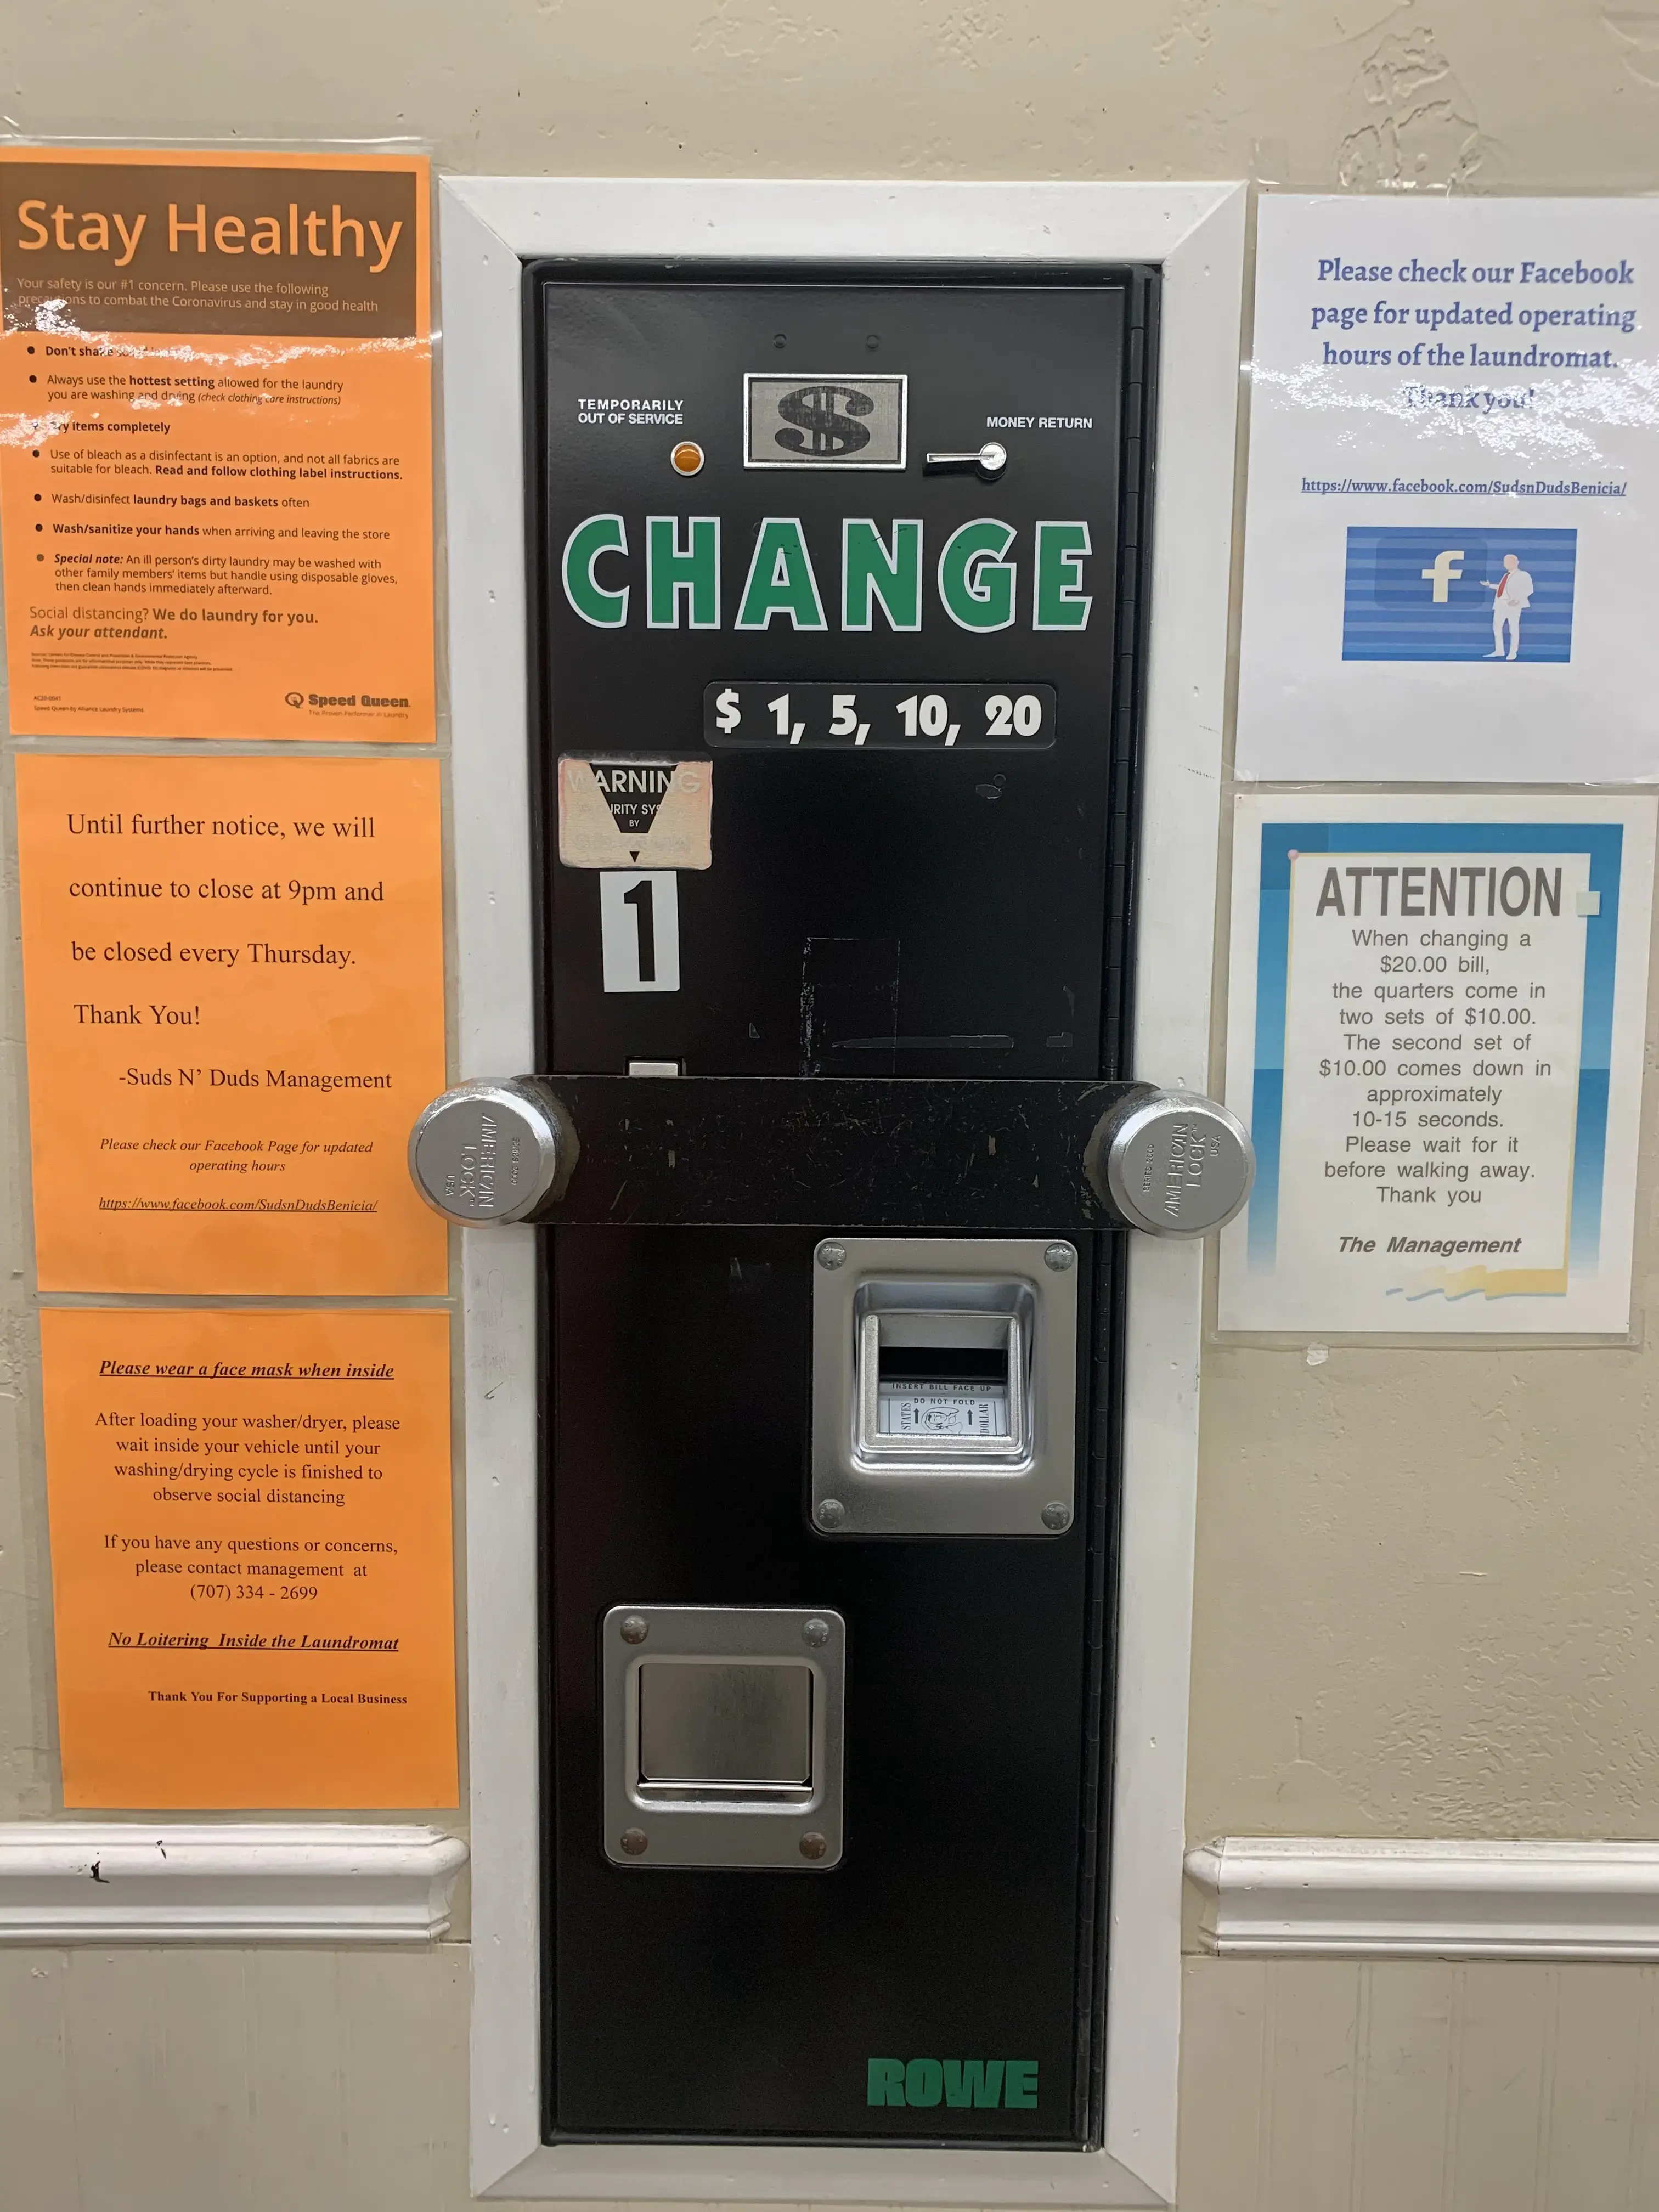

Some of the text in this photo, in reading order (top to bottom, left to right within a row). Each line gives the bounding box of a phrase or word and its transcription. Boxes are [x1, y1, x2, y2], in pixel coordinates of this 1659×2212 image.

[19, 200, 403, 273] Stay Healthy
[1318, 257, 1634, 284] Please check our Facebook
[1311, 301, 1637, 333] page for updated operating
[1323, 341, 1618, 368] hours of the laundromat.
[578, 399, 683, 410] TEMPORARILY
[578, 413, 682, 424] OUT OF SERVICE
[987, 417, 1092, 428] MONEY RETURN
[1302, 478, 1627, 496] https://www.facebook.com/SudsnDudsBenicia/
[52, 494, 309, 508] Wash/disinfect laundry bags and baskets often
[53, 524, 390, 541] Wash/sanitize your hands when arriving and leaving the store
[562, 514, 1093, 632] CHANGE
[30, 607, 318, 626] Social distancing? We do laundry for you.
[30, 625, 167, 640] Ask your attendant.
[309, 694, 356, 708] Speed
[715, 689, 1042, 746] $ 1, 5, 10, 20
[67, 814, 374, 839] Until further notice, we will
[70, 877, 384, 905] continue to close at 9pm and
[1316, 867, 1561, 916] ATTENTION
[624, 880, 655, 982] 1
[1352, 930, 1531, 951] When changing a
[71, 941, 355, 969] be closed every Thursday.
[1380, 955, 1489, 975] $20.00 bill,
[1333, 982, 1545, 1002] the quarters come in
[74, 1005, 199, 1025] Thank You!
[1340, 1007, 1535, 1026] two sets of $10.00.
[119, 1068, 172, 1085] -Suds
[210, 1070, 259, 1086] Duds
[266, 1070, 392, 1092] Management
[1367, 1085, 1502, 1106] approximately
[1353, 1111, 1503, 1127] 10-15 seconds.
[1210, 1135, 1221, 1156] USA
[478, 1113, 498, 1207] AMERICAN
[1164, 1123, 1188, 1217] AMERICAN
[445, 1175, 455, 1196] USA
[99, 1197, 378, 1212] https://www.facebook.com/SudsnDudsBenicia/
[1340, 1237, 1522, 1257] The Management
[99, 1361, 393, 1380] Please wear a face mask when inside
[901, 1402, 911, 1430] STATES
[978, 1404, 989, 1436] DOLLAR
[191, 1584, 230, 1601] (707)
[236, 1585, 264, 1599] 334
[280, 1586, 317, 1599] 2699
[109, 1633, 398, 1652] No Loitering Inside the Laundromat
[148, 1691, 187, 1701] Thank
[191, 1692, 212, 1701] You
[218, 1692, 238, 1701] For
[242, 1692, 307, 1705] Supporting
[322, 1694, 353, 1703] Local
[358, 1694, 407, 1703] Business
[867, 2058, 1038, 2109] ROWE
